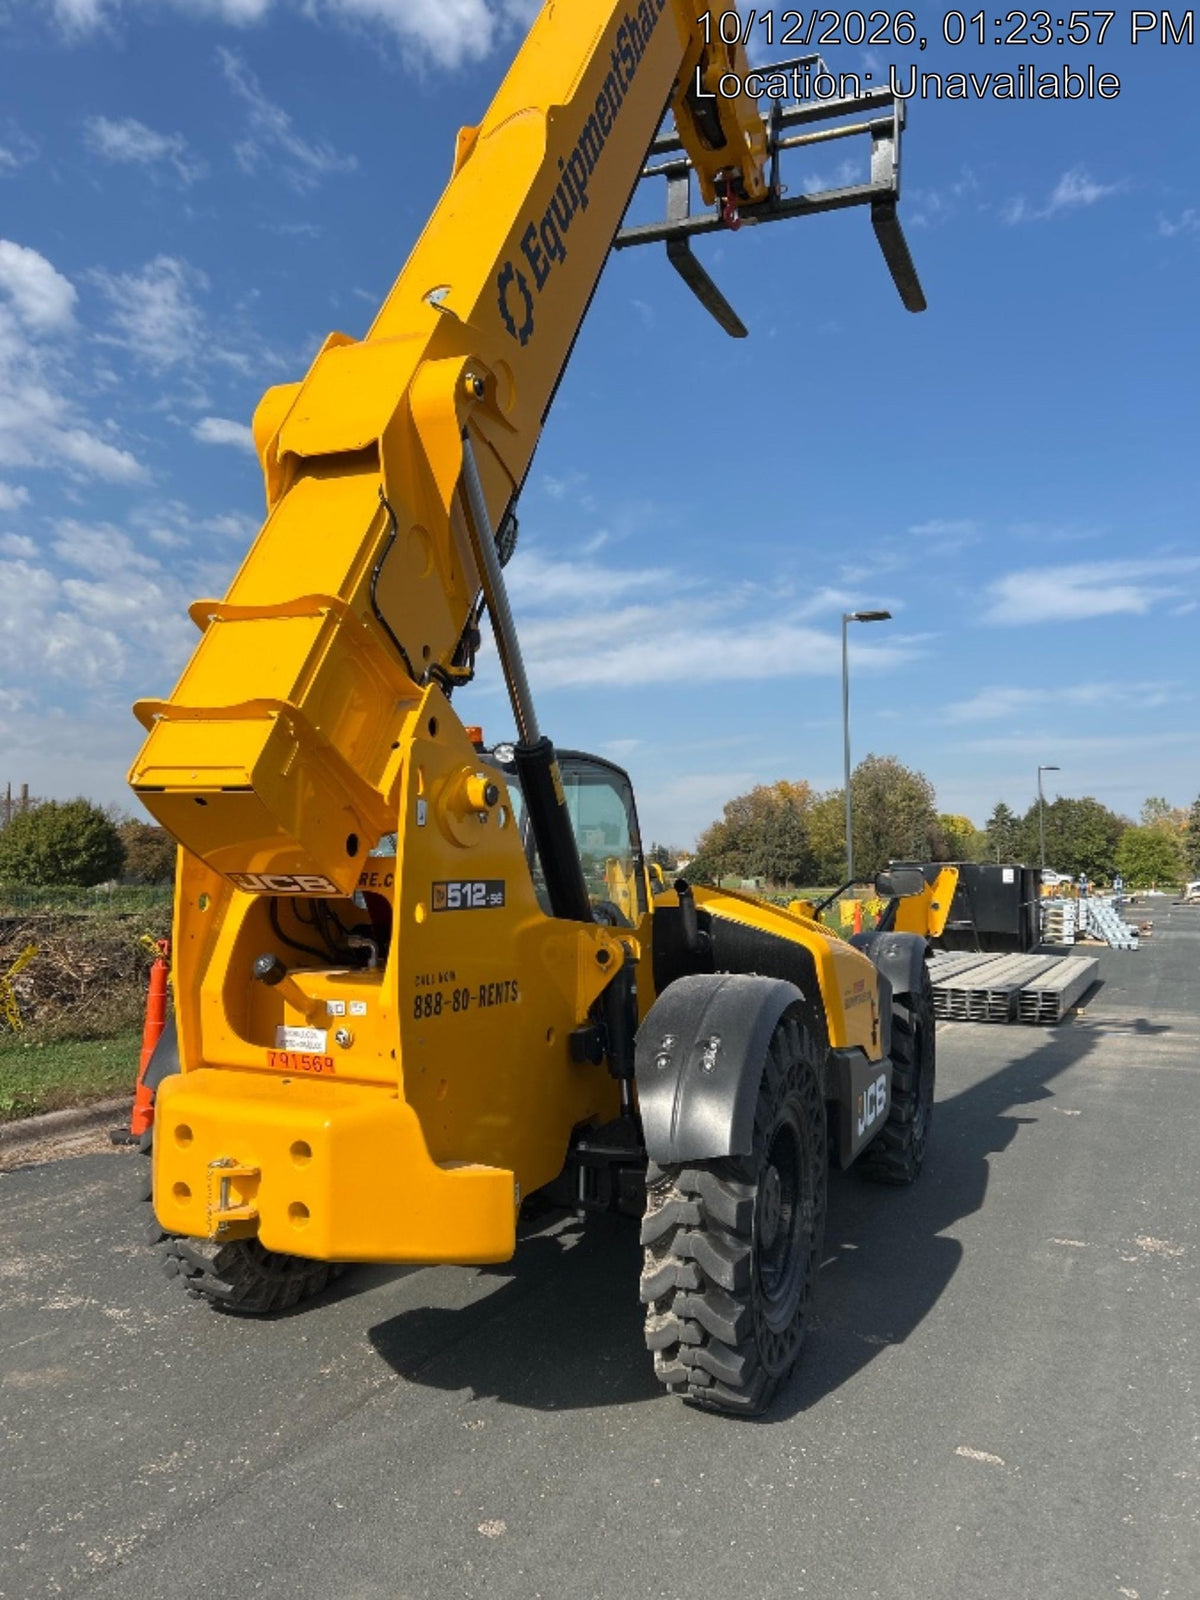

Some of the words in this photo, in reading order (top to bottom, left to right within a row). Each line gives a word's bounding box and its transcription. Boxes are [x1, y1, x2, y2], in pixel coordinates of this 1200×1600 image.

[237, 874, 337, 893] JCB
[413, 978, 519, 1020] 888-80-RENTS
[268, 1052, 335, 1073] 791569
[857, 1073, 887, 1137] JCB
